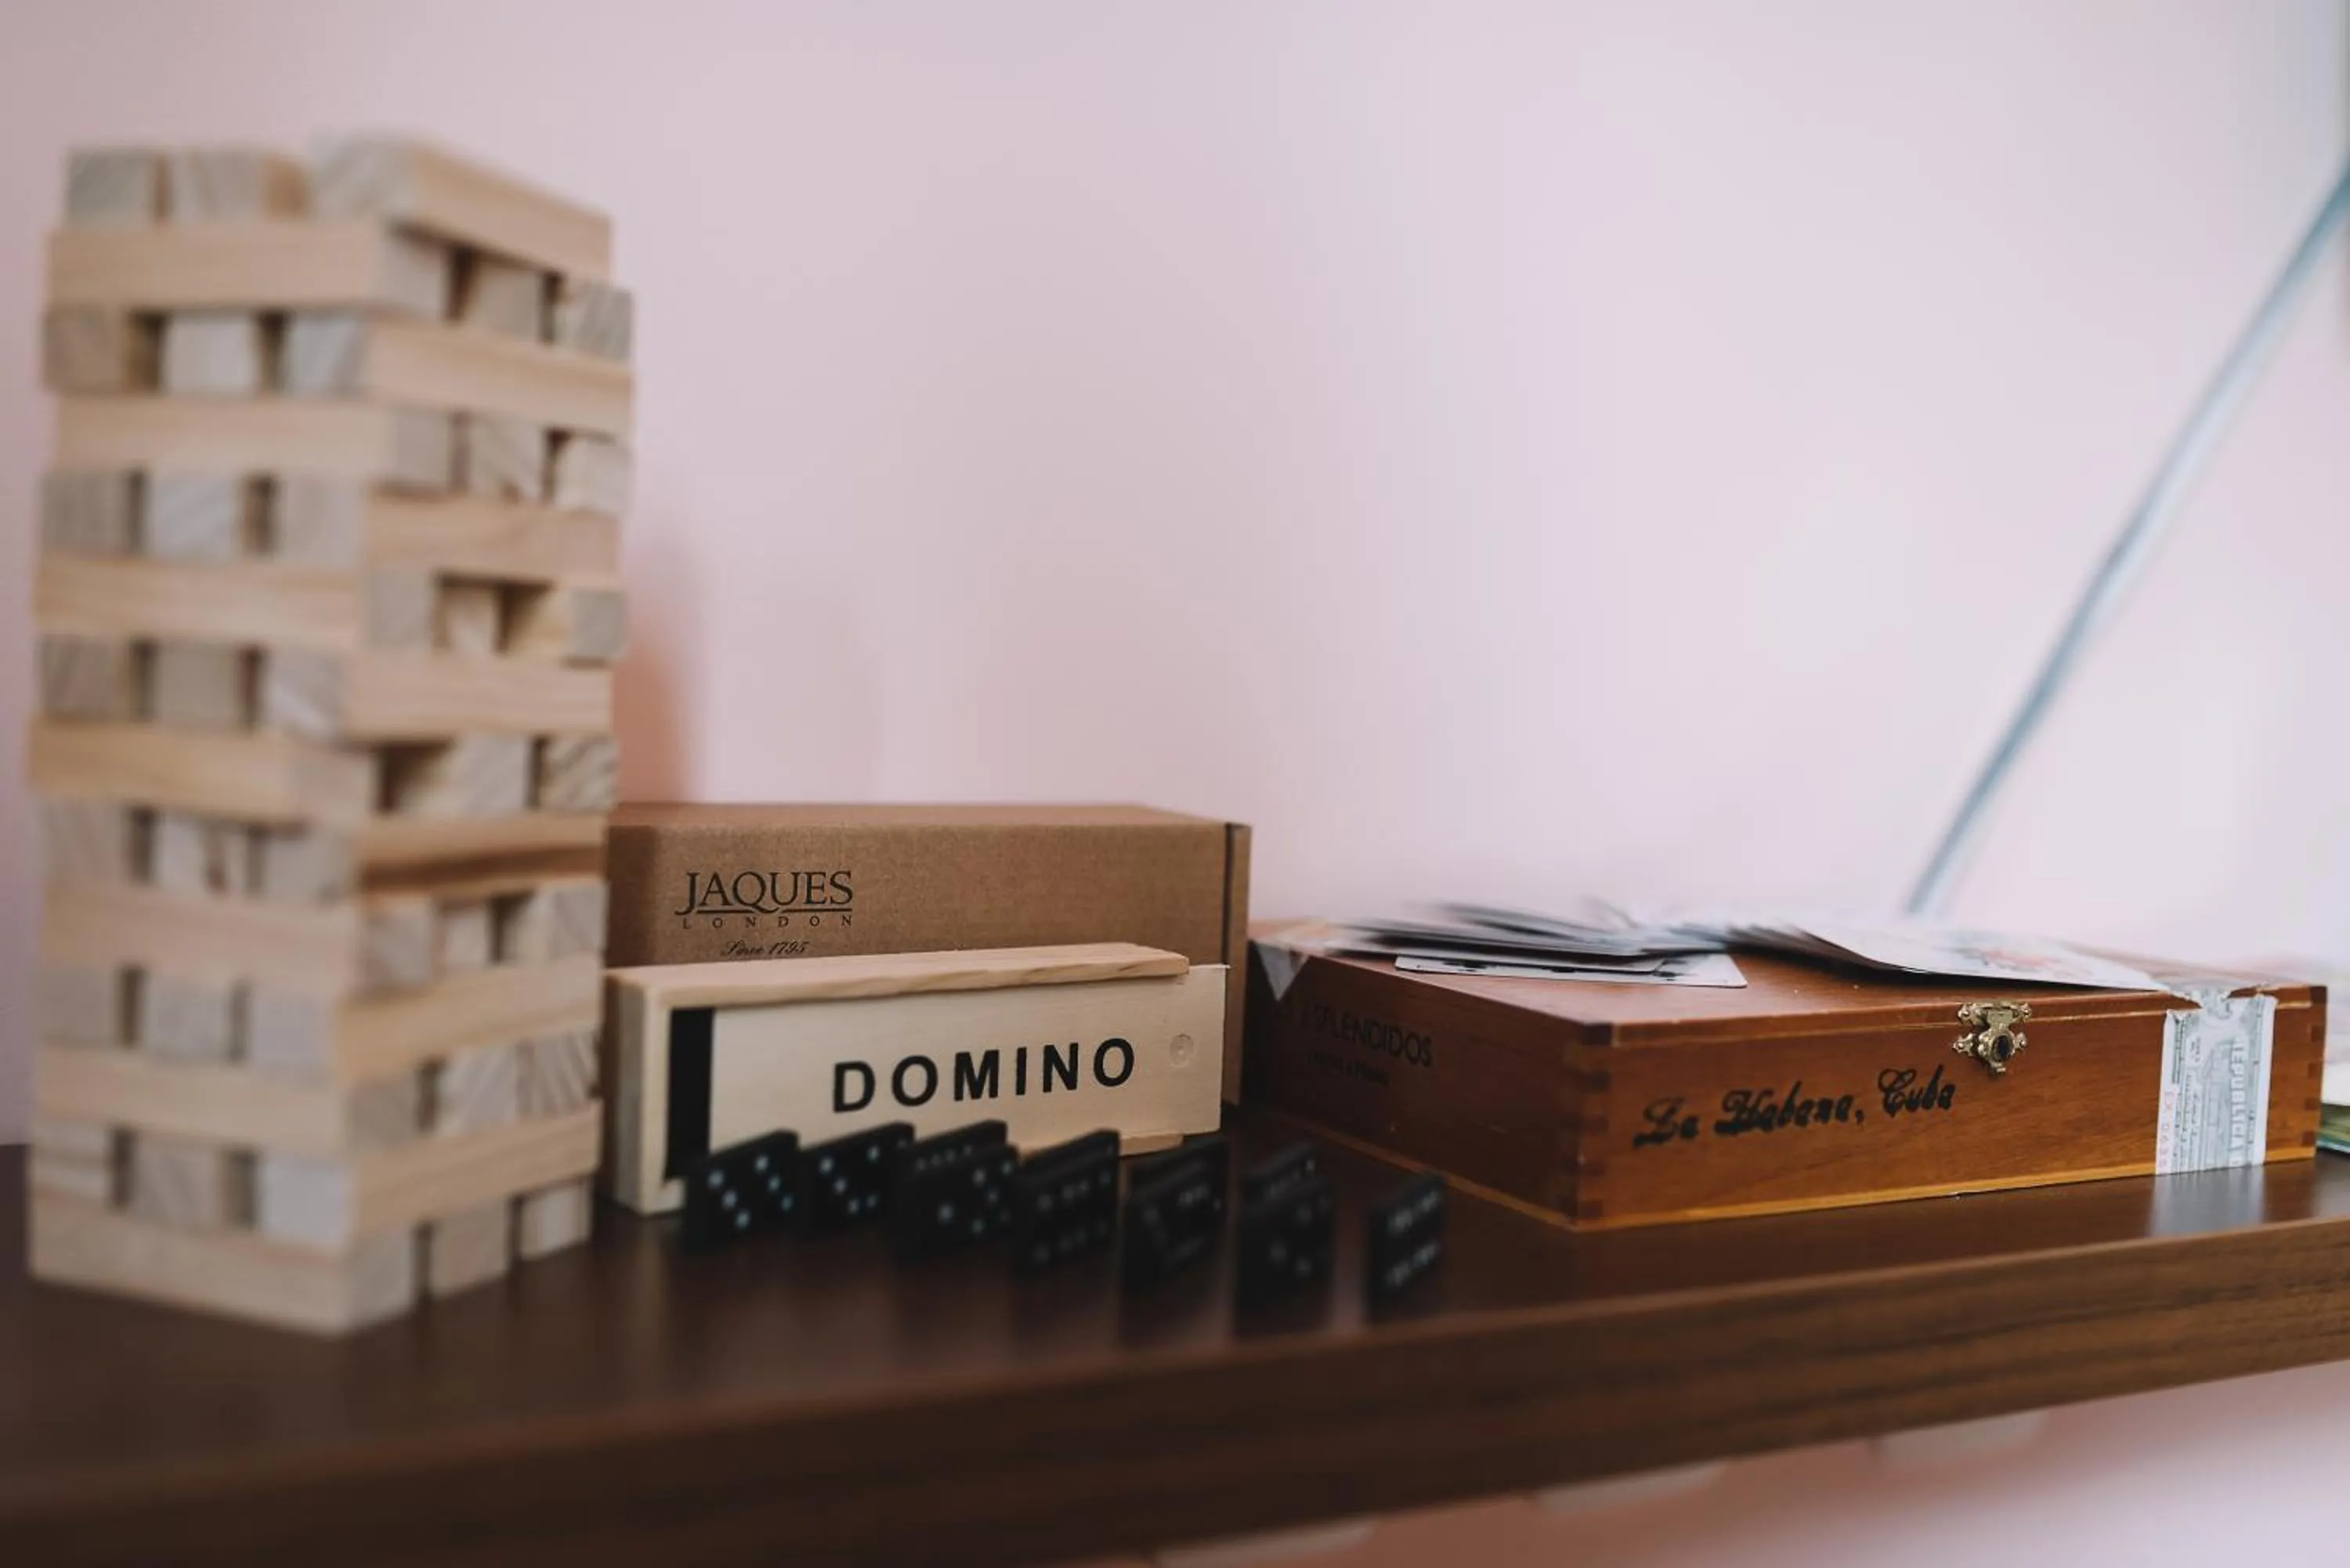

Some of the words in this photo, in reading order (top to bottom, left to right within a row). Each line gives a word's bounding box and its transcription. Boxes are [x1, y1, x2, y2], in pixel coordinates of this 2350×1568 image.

[674, 870, 853, 916] JAQUES
[682, 915, 851, 929] LONDON
[768, 940, 809, 954] 1795
[833, 1038, 1135, 1113] DOMINO
[1633, 1098, 1698, 1147] La
[1878, 1065, 1956, 1117] Cuba
